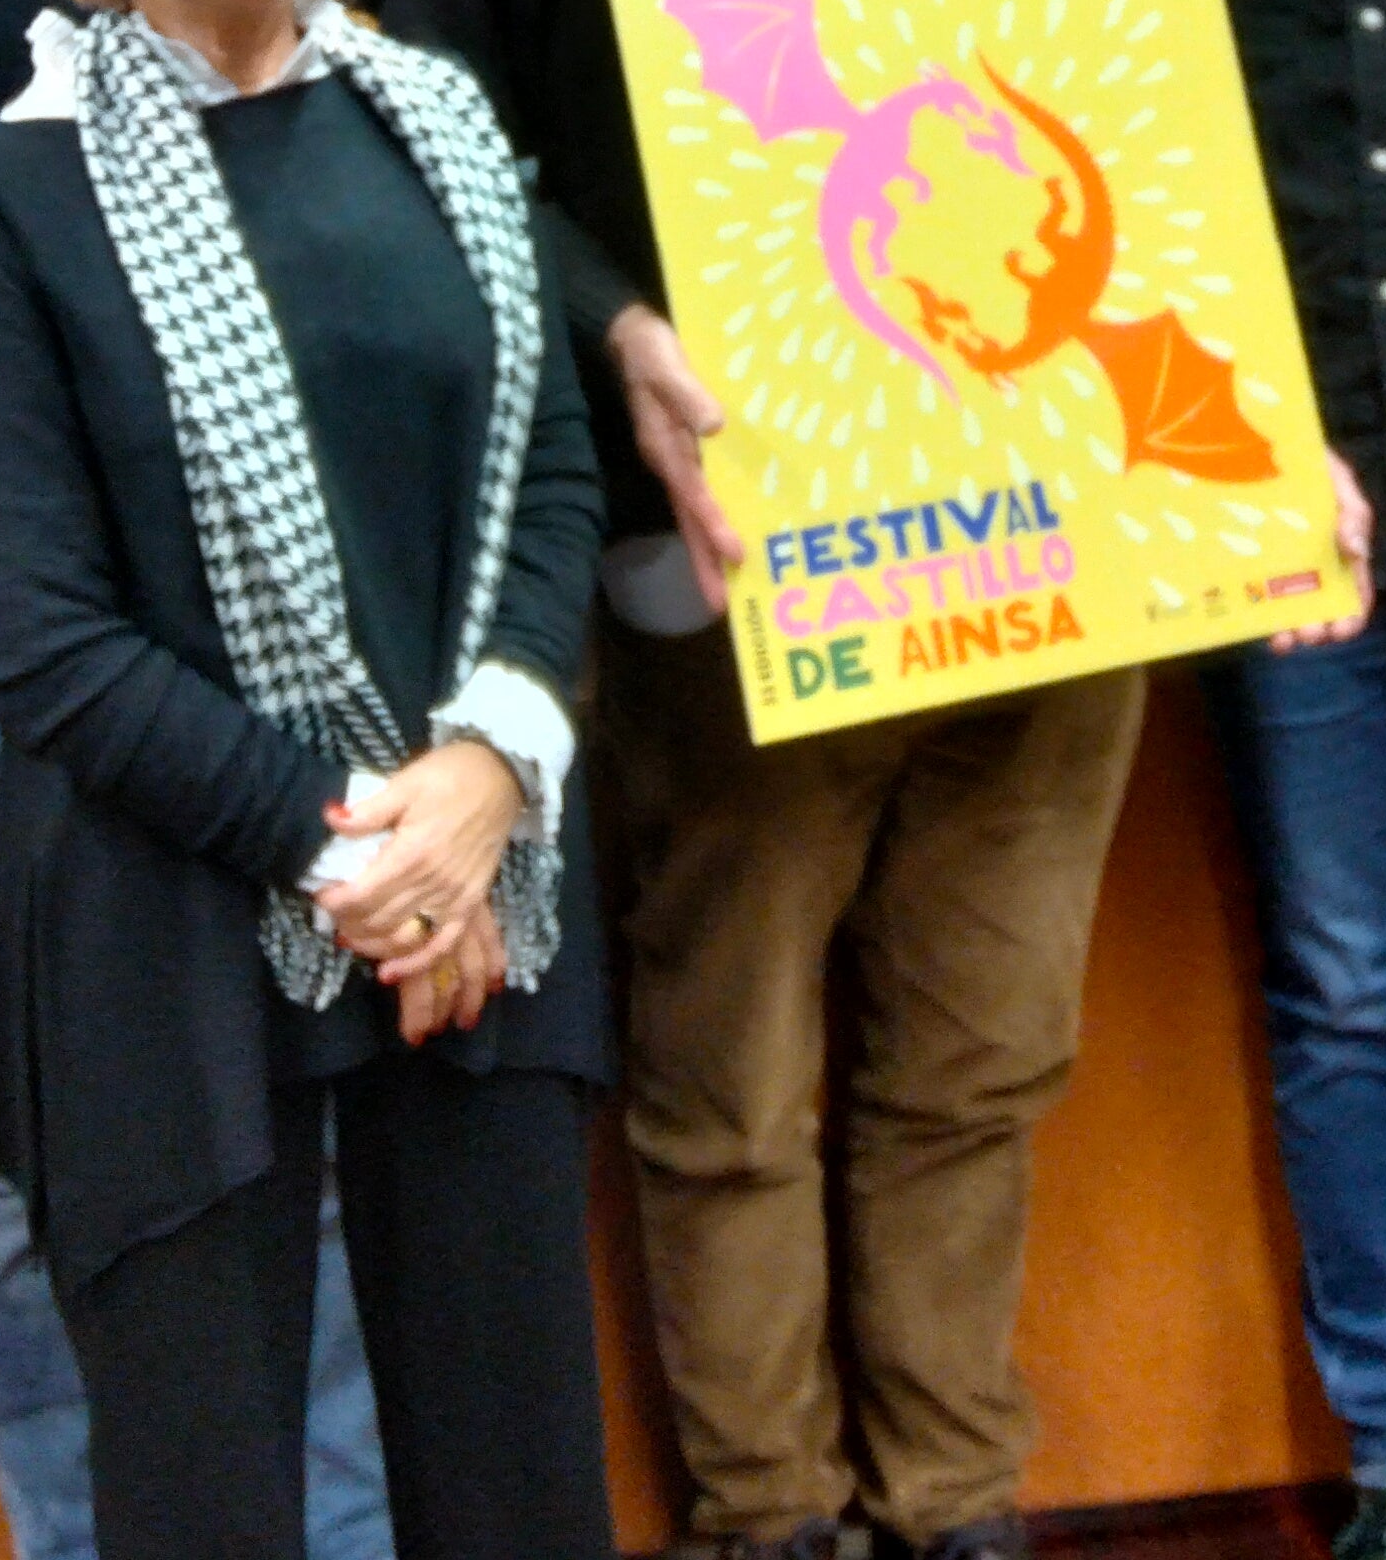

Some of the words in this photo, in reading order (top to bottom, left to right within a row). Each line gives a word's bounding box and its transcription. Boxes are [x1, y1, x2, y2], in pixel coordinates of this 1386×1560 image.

[766, 480, 1059, 584] FESTIVAL
[774, 534, 1075, 638] CASTILLO
[786, 635, 874, 701] DE
[899, 594, 1086, 678] AINSA
